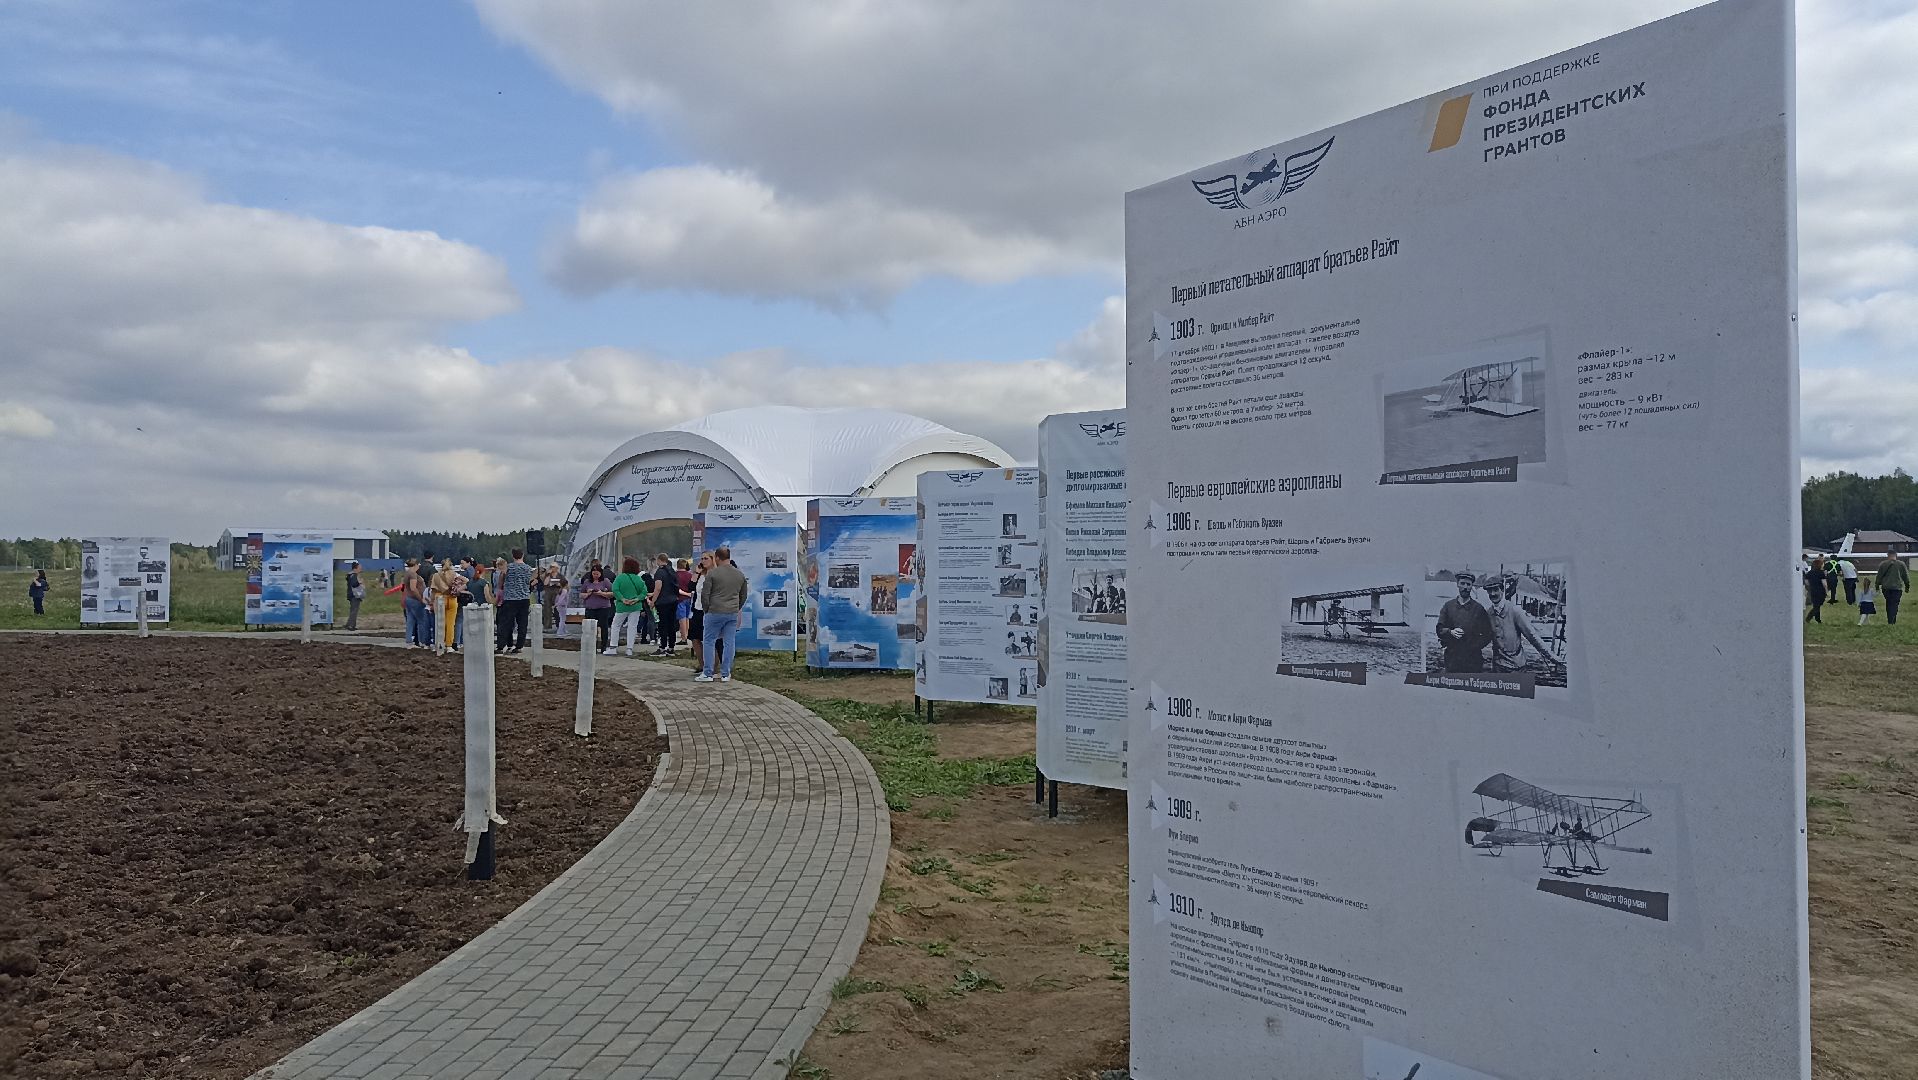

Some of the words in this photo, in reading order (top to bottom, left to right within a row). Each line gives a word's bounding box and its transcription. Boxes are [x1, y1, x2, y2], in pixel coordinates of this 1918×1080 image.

[1484, 82, 1508, 98] ПРИ
[1512, 52, 1600, 88] ПОДДЕРЖКЕ
[1484, 89, 1550, 118] ФОНДА
[1484, 82, 1646, 141] ПРЕЗИДЕНТСКИХ
[1484, 128, 1566, 162] ГРАНТОВ
[1234, 216, 1255, 230] АБН
[1258, 206, 1287, 223] АЭРО
[1171, 282, 1207, 306] Первый
[1209, 265, 1275, 296] летательный
[1276, 256, 1320, 280] аппарат
[1323, 246, 1369, 274] братьев
[1371, 238, 1400, 260] Райт
[1170, 317, 1194, 341] 1903
[1197, 324, 1204, 336] г.
[1260, 312, 1275, 324] Райт
[1578, 362, 1610, 374] размах
[1612, 358, 1642, 369] крыла
[1606, 372, 1622, 381] 283
[1624, 371, 1634, 379] кг
[1578, 400, 1626, 410] мощность
[1638, 396, 1644, 404] 9
[1646, 394, 1663, 402] кВт
[1600, 410, 1622, 418] более
[1624, 407, 1632, 415] 12
[1634, 404, 1680, 414] лошадиных
[1682, 401, 1700, 410] сил)
[1607, 421, 1617, 429] 77
[1620, 421, 1629, 429] кг
[1496, 466, 1510, 475] Райт
[1168, 481, 1204, 502] Первые
[1207, 478, 1275, 500] европейские
[1278, 474, 1342, 496] аэропланы
[1166, 512, 1191, 530] 1906
[1194, 520, 1200, 530] г.
[1498, 680, 1520, 690] Вуазен
[1167, 696, 1192, 718] 1908
[1195, 707, 1202, 719] г.
[1232, 712, 1247, 726] Анри
[1247, 714, 1272, 728] Фарман
[1167, 796, 1192, 820] 1909
[1195, 810, 1202, 823] г.
[1170, 892, 1194, 918] 1910
[1198, 907, 1204, 920] г.
[1232, 920, 1240, 930] де
[1586, 888, 1616, 902] Самолёт
[1617, 894, 1647, 909] Фарман
